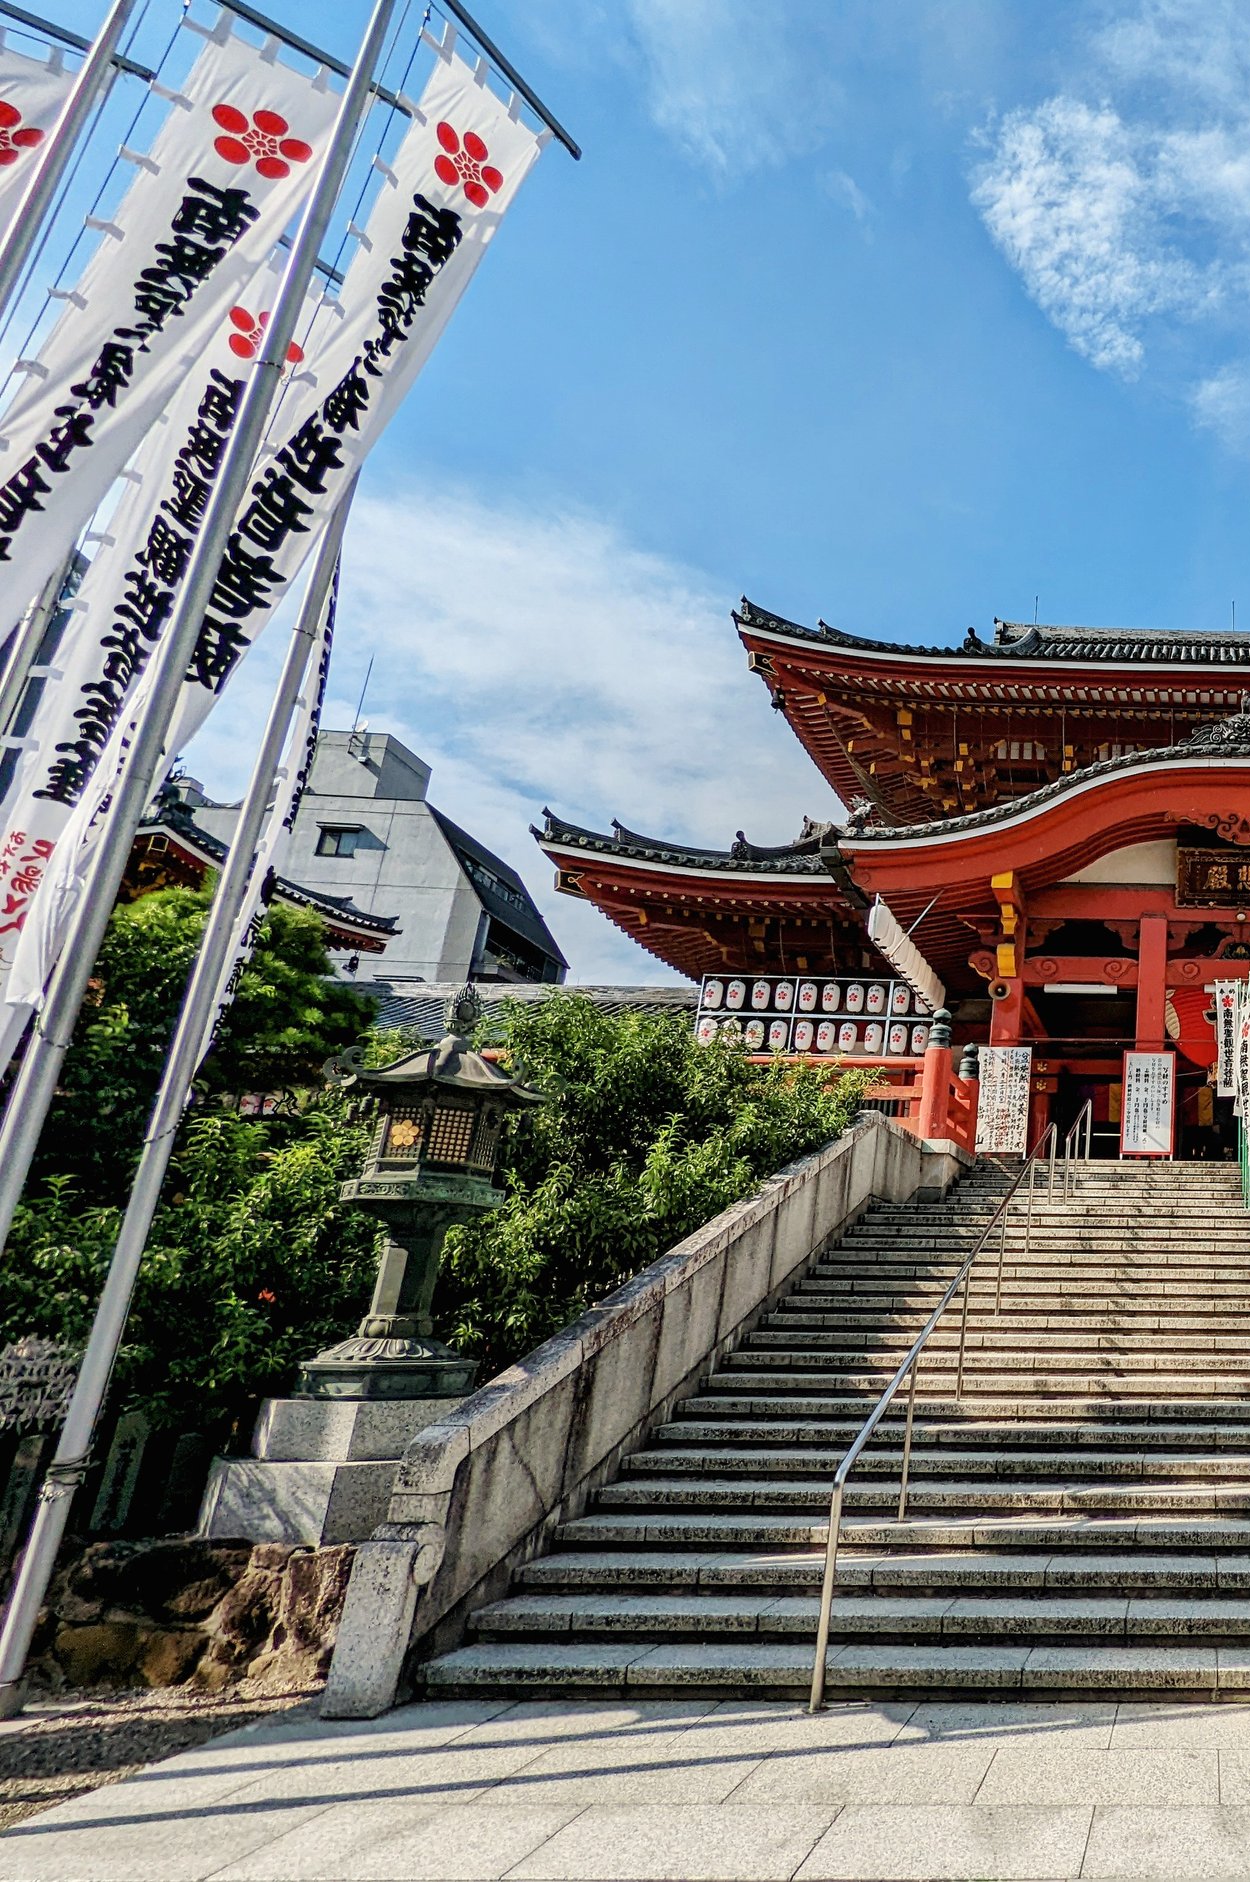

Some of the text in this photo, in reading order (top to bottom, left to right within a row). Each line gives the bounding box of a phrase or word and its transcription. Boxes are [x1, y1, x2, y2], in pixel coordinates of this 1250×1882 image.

[1223, 1008, 1235, 1088] 南無聖観世音菩薩
